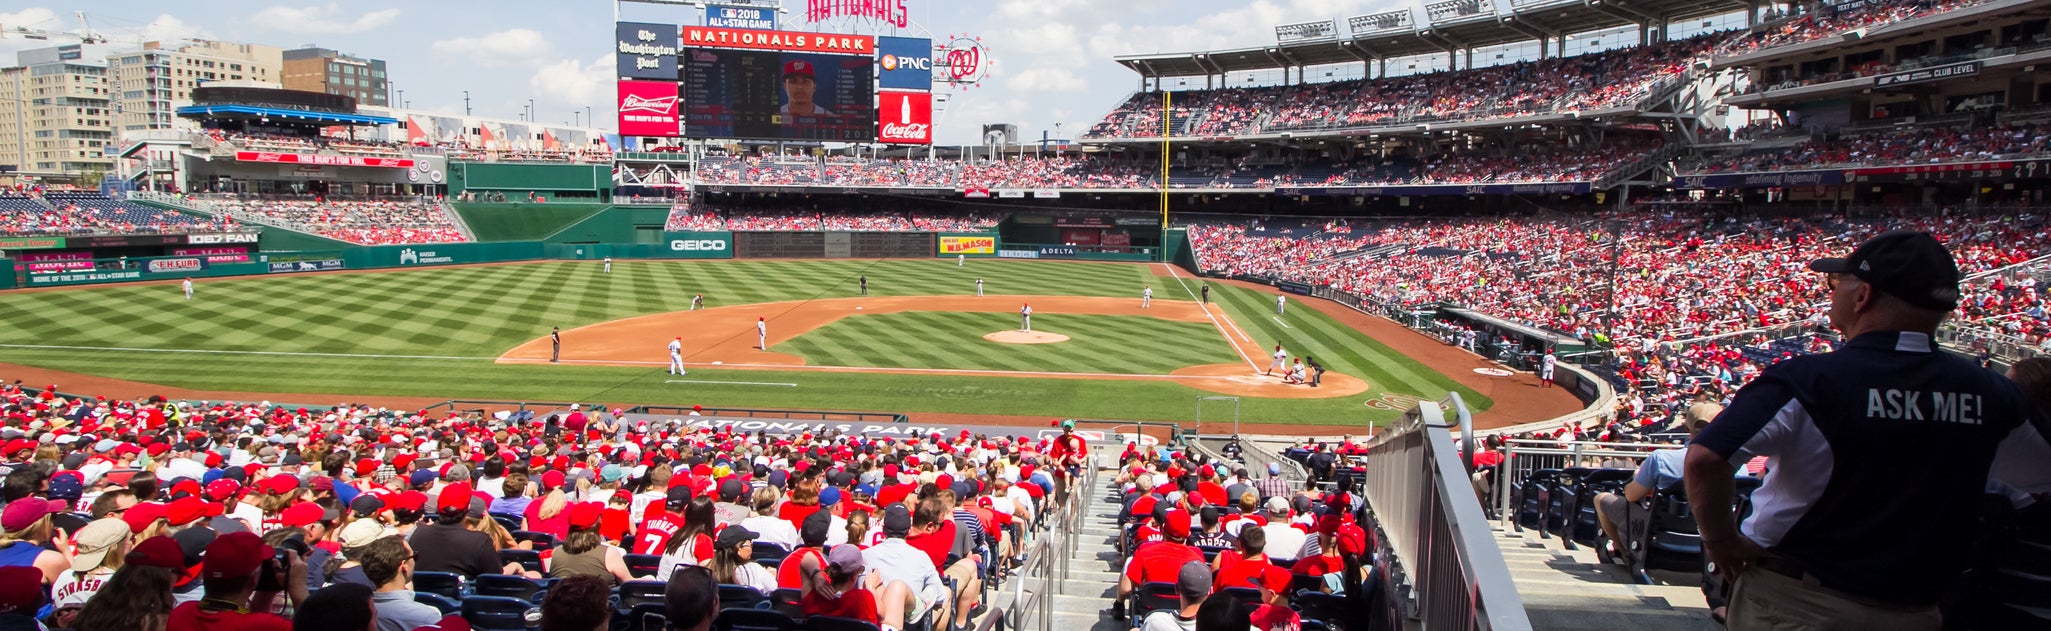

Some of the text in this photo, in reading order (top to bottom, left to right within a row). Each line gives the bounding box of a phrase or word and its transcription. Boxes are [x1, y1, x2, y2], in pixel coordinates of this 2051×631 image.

[737, 9, 760, 19] 2018
[749, 20, 772, 29] GAME
[638, 29, 656, 41] The
[690, 29, 864, 50] NATIONALS PARK
[619, 41, 676, 57] Washington
[637, 57, 659, 70] Post
[898, 56, 930, 70] PNC
[1934, 67, 1952, 77] CLUB
[1953, 64, 1975, 74] LEVEL
[624, 98, 671, 108] Budweiser
[882, 122, 929, 139] Coca-Cola
[298, 154, 313, 163] THIS
[314, 155, 335, 164] BUD'S
[337, 156, 349, 165] FOR
[1684, 177, 1707, 187] SAIC
[1785, 173, 1823, 184] Ingenuity
[1466, 186, 1486, 194] SAIC
[226, 233, 259, 243] FAN
[671, 240, 726, 250] GEICO
[1867, 388, 1982, 425] ASK ME!
[861, 424, 949, 436] PARK
[647, 519, 679, 535] TURNER
[644, 533, 662, 555] 7
[58, 579, 107, 601] STRASB
